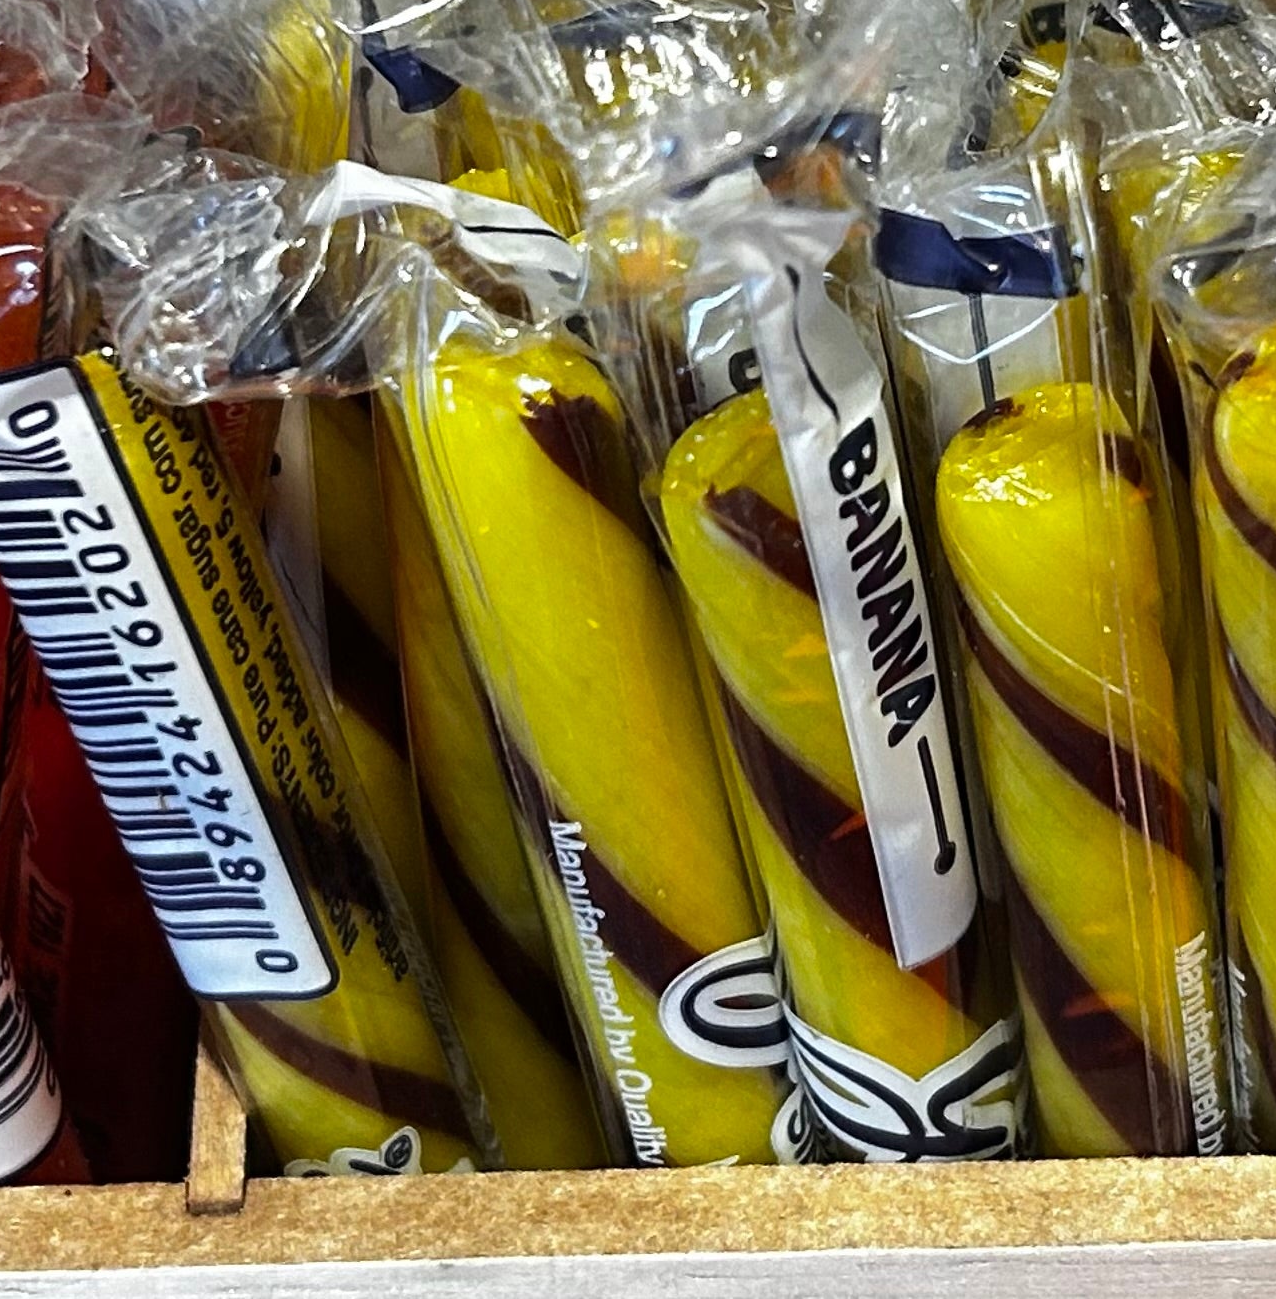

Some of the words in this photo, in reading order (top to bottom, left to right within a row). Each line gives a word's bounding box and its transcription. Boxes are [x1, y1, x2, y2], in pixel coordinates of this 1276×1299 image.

[183, 443, 220, 503] red
[59, 493, 178, 687] 16202
[168, 488, 224, 591] sugar,
[223, 531, 280, 628] yellow
[829, 417, 938, 748] BANANA
[207, 587, 255, 666] cane
[257, 622, 313, 727] added,
[238, 662, 282, 740] Pure
[154, 706, 270, 892] 89424
[251, 935, 302, 984] 0
[547, 815, 634, 1028] Manufactured
[1172, 930, 1227, 1134] Manufactured
